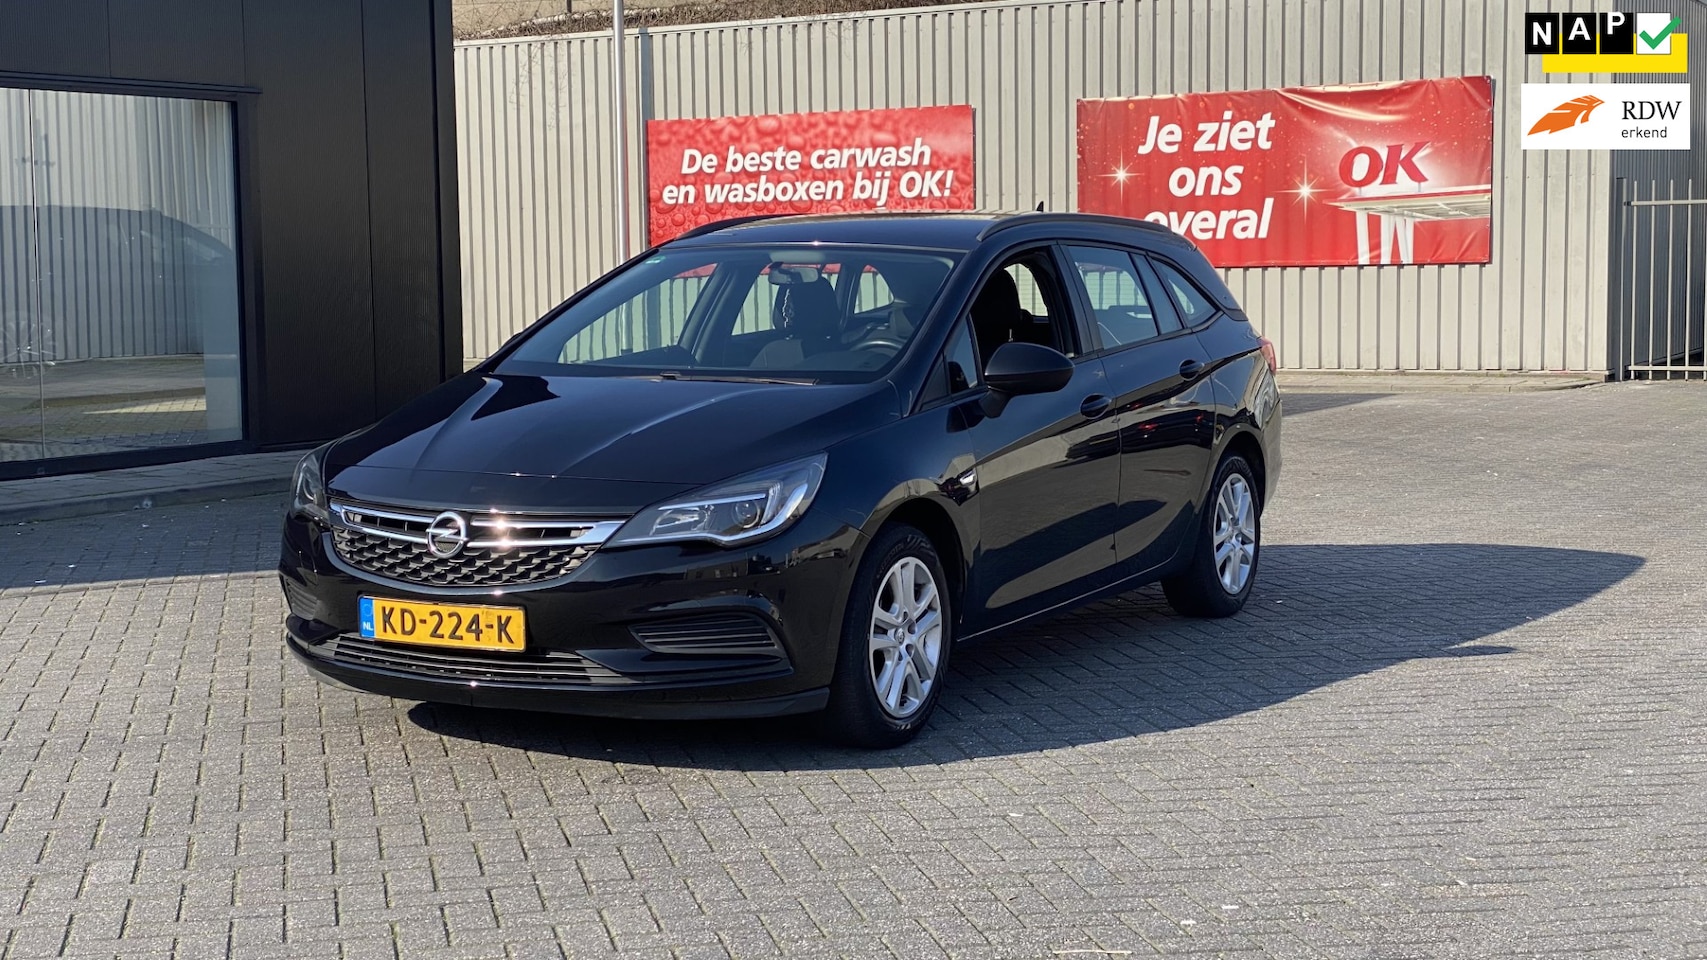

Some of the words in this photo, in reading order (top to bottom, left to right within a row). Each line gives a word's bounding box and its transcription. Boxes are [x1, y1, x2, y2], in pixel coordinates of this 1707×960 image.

[1137, 115, 1182, 155] Je
[1193, 111, 1275, 152] ziet
[681, 149, 718, 175] De
[725, 146, 800, 174] beste
[810, 137, 931, 170] carwash
[1340, 143, 1430, 187] OK
[662, 185, 695, 204] en
[705, 175, 844, 203] wasboxen
[852, 172, 890, 206] bij
[899, 170, 953, 198] OK!
[1168, 165, 1244, 197] ons
[363, 621, 374, 631] NL
[381, 606, 514, 643] KD-224-K
